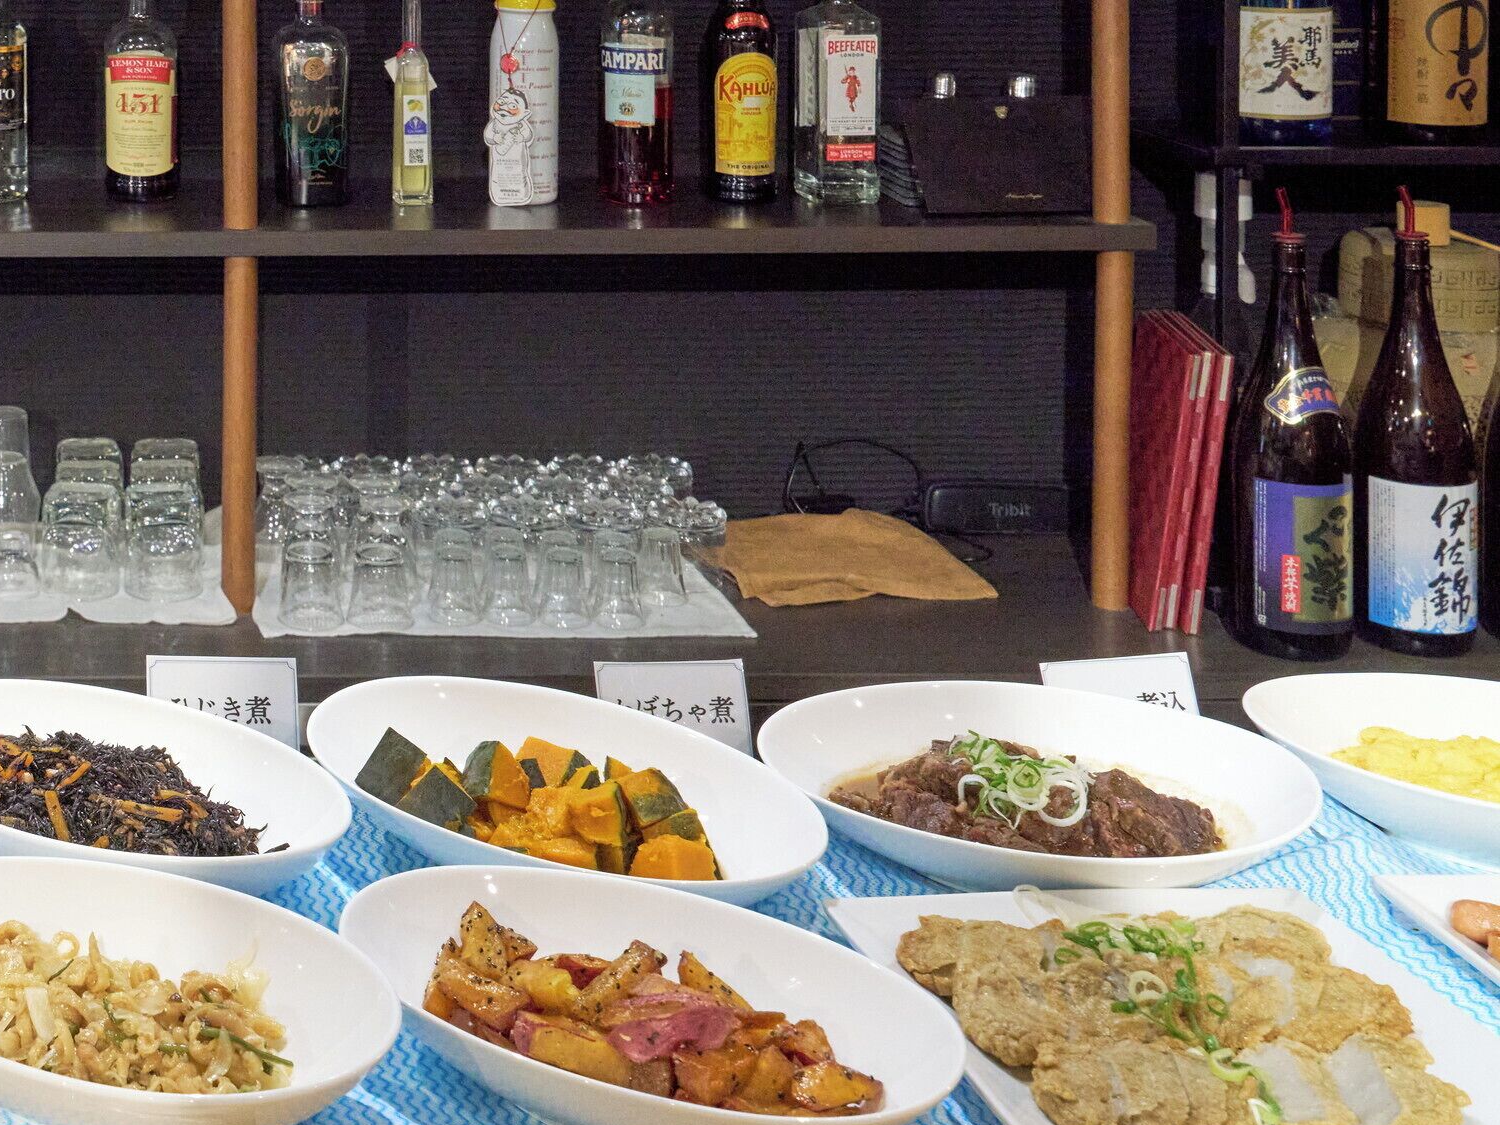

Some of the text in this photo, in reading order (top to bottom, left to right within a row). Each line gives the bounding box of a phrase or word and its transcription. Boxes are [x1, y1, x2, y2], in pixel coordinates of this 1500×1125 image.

[828, 40, 876, 55] BEEFEATER
[111, 59, 170, 68] LEMON HART
[1257, 36, 1320, 101] 美人
[118, 93, 159, 114] 151
[1428, 494, 1471, 624] 伊佐錦
